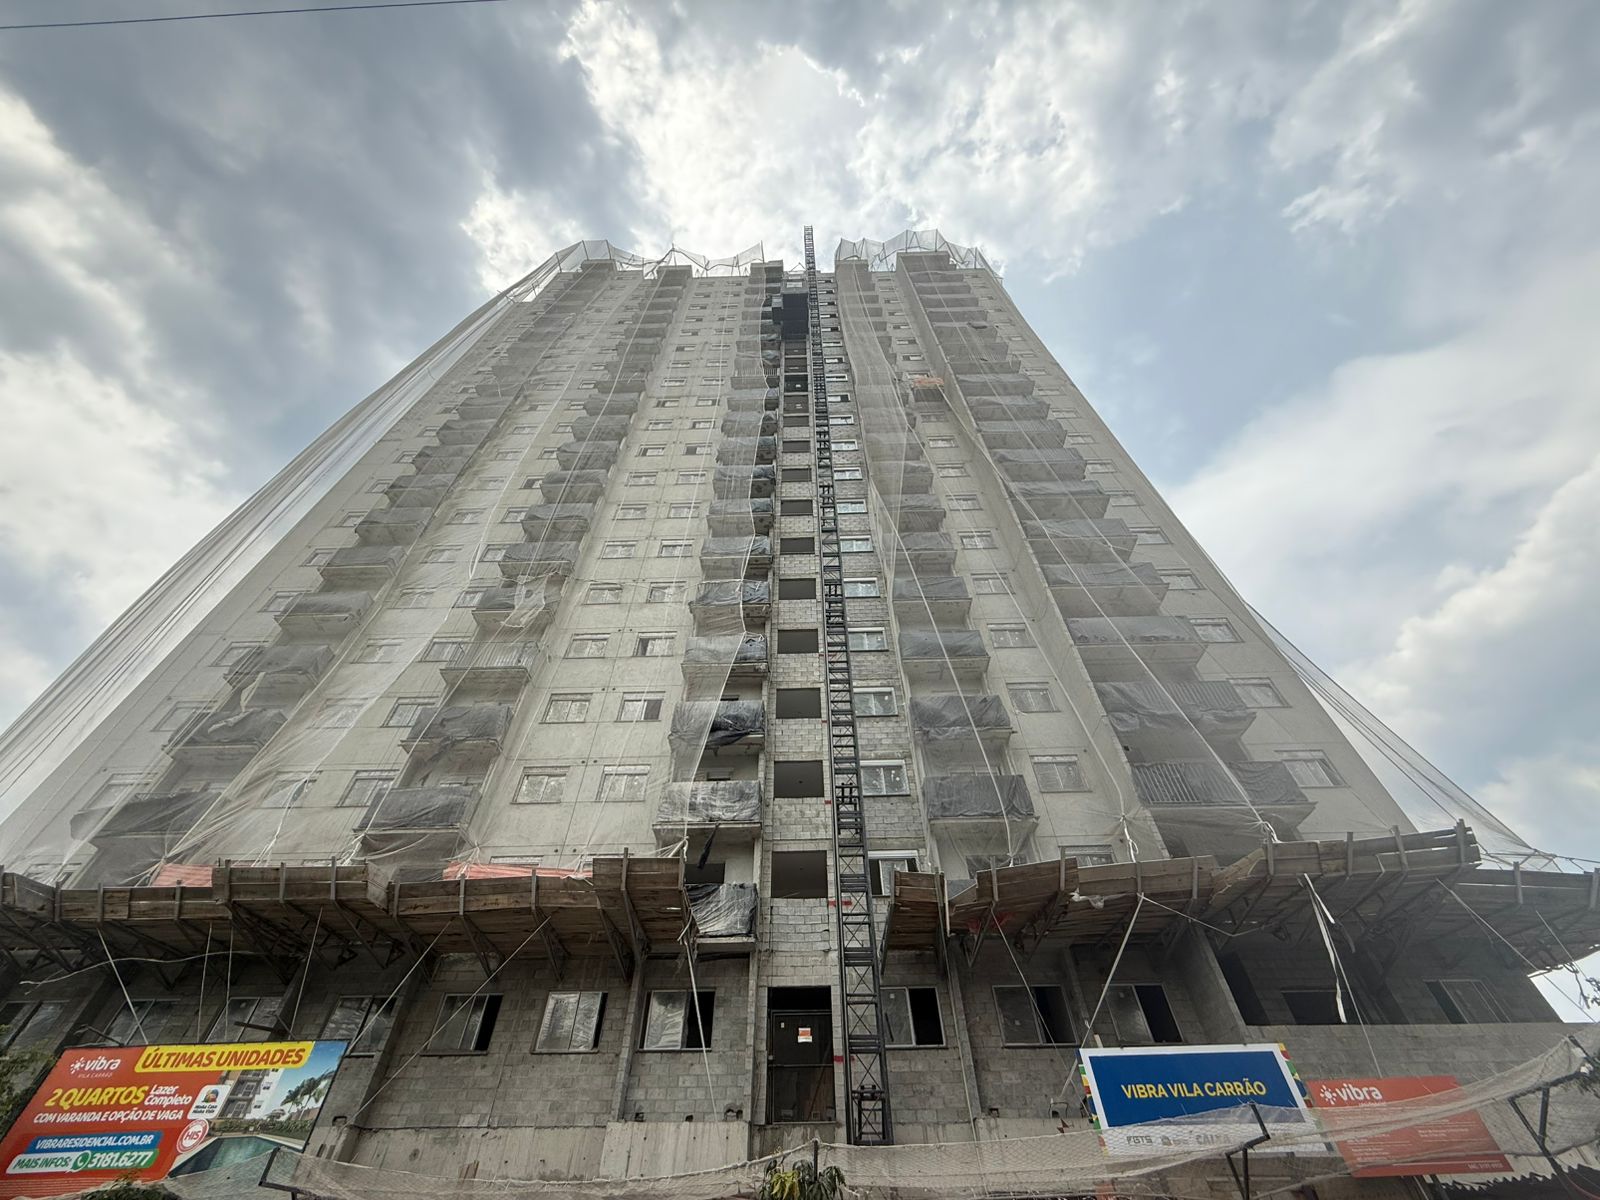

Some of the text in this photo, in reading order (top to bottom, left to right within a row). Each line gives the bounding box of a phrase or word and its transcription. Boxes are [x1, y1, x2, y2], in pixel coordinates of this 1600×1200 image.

[84, 1056, 121, 1071] vibra
[141, 1048, 306, 1069] ÚLTIMAS UNIDADES
[150, 1084, 179, 1095] Lazer
[1120, 1077, 1268, 1099] VIBRA VILA CARRÃO
[1335, 1083, 1383, 1101] vibra
[144, 1094, 192, 1108] Completo
[33, 1107, 184, 1124] COM VARANDA E OPÇÃO DE VAGA
[35, 1134, 155, 1150] VIBRARESIDENCIAL.COM.BR
[184, 1130, 202, 1140] HIS
[12, 1151, 154, 1169] MAIS INFOS: 3181.6277
